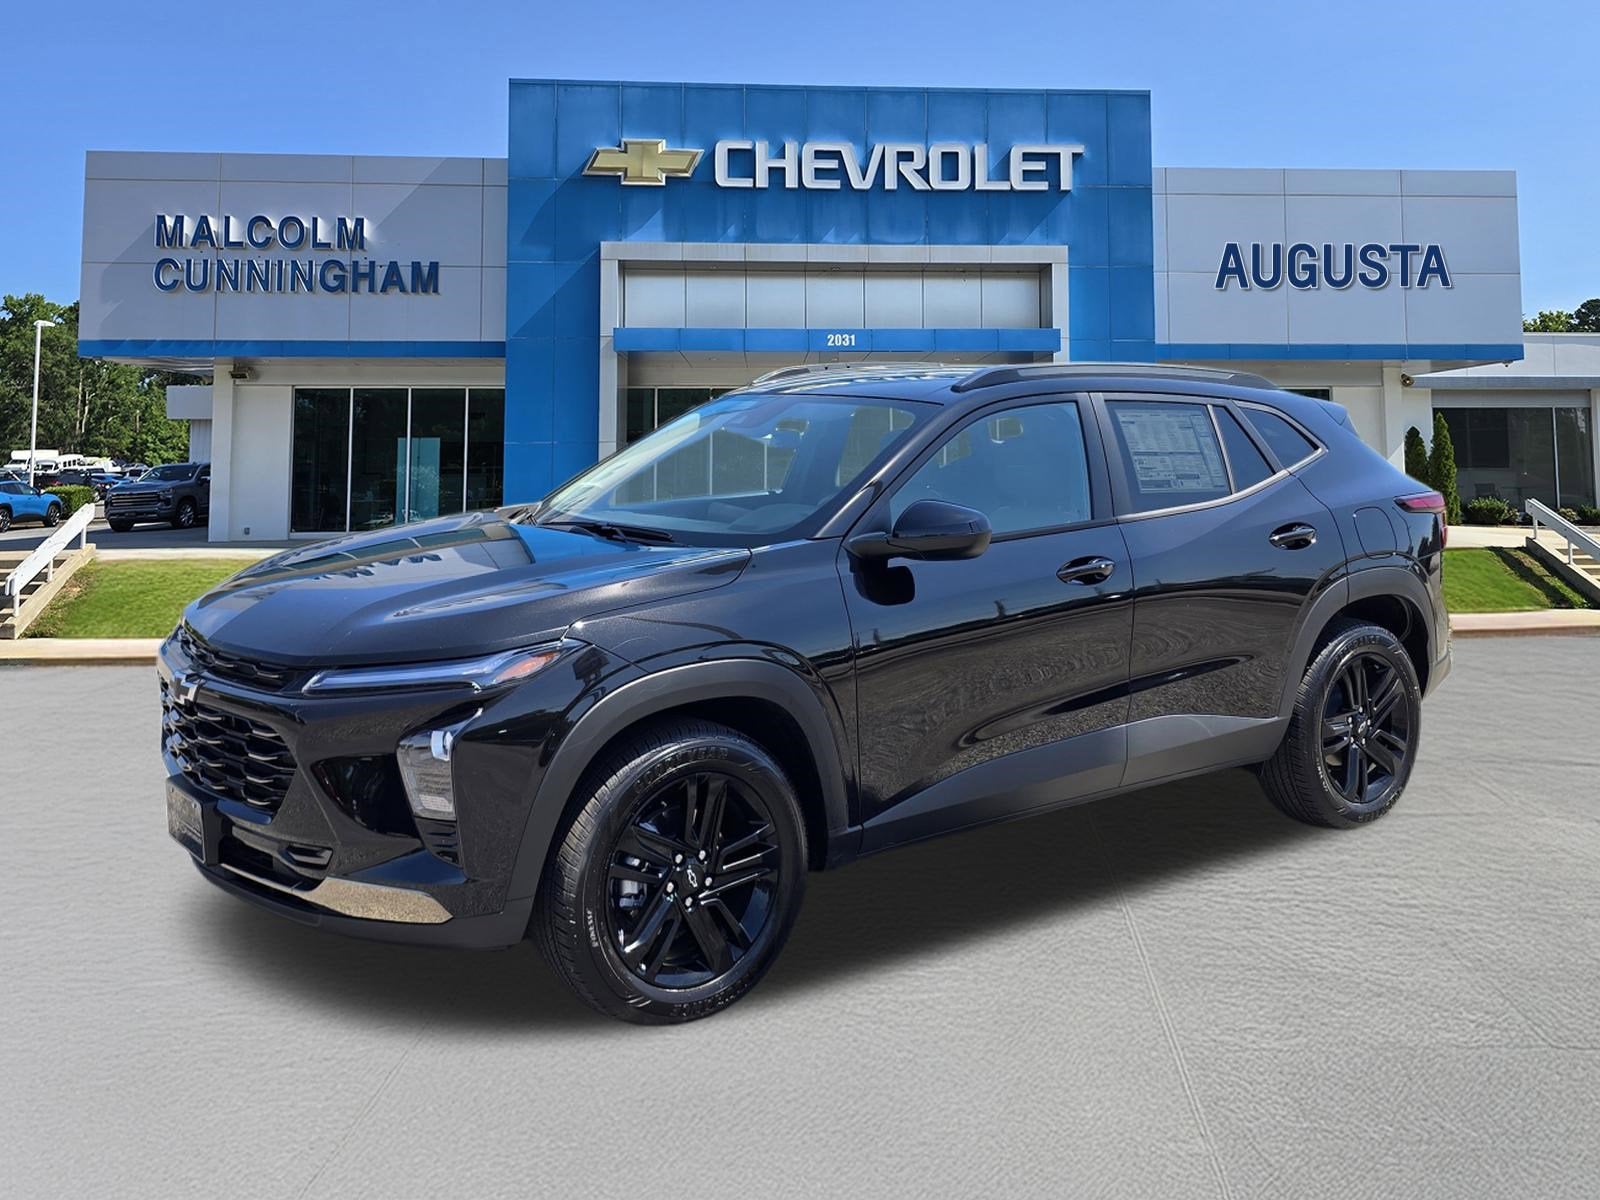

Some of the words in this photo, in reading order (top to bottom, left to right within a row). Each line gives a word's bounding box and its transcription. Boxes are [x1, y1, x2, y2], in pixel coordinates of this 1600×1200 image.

[714, 140, 1085, 192] CHEVROLET
[155, 214, 366, 250] MALCOLM
[153, 257, 441, 295] CUNNINGHAM
[1215, 241, 1452, 290] AUGUSTA
[827, 334, 856, 347] 2031
